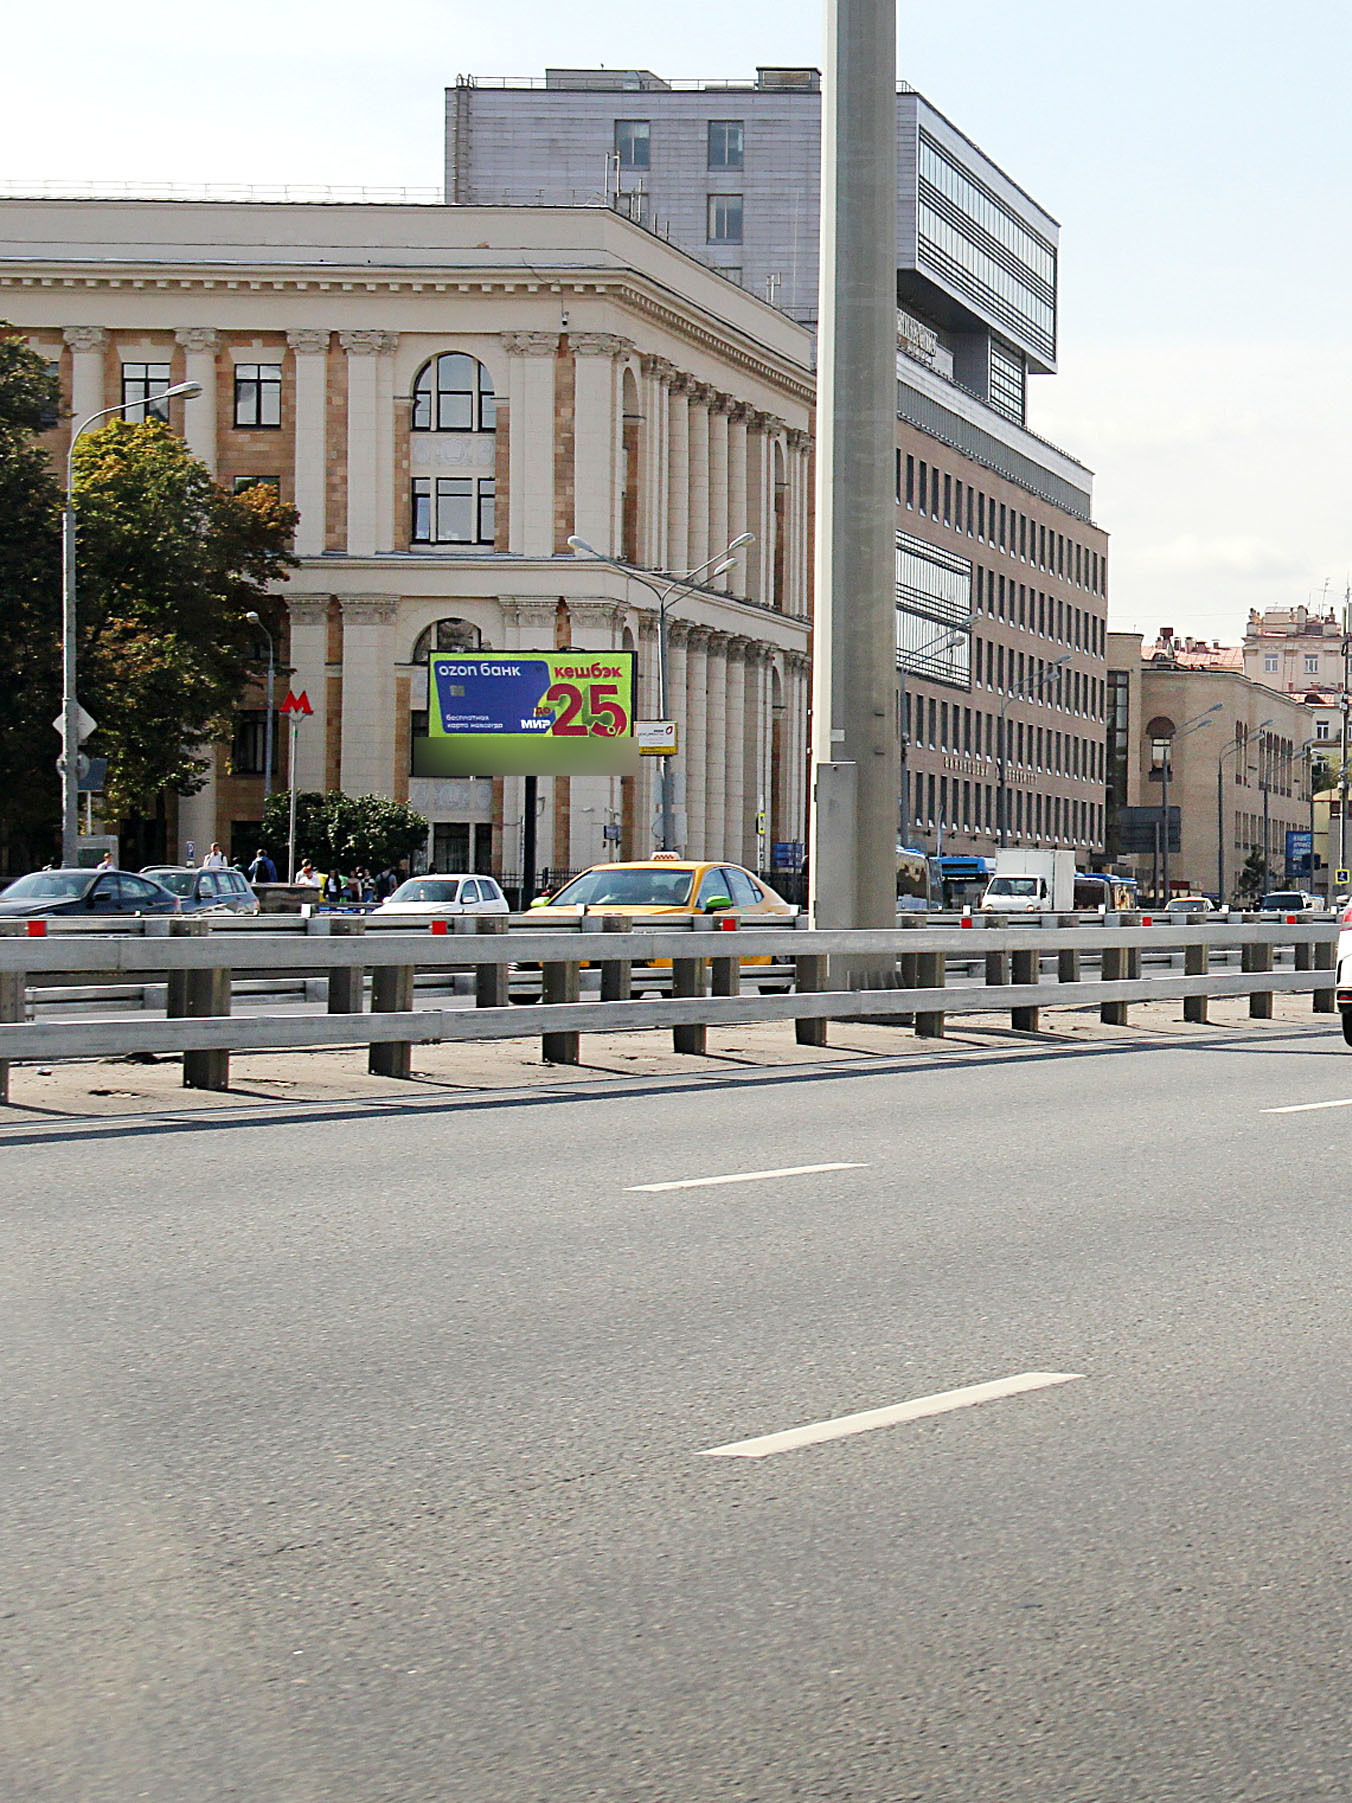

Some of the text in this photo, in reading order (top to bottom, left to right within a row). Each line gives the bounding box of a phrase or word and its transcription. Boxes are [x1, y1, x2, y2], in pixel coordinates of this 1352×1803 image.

[438, 662, 521, 676] ozon банк
[554, 662, 623, 678] кешбэк
[535, 706, 552, 717] до
[446, 713, 490, 721] бесплатная
[447, 722, 469, 730] карта
[520, 719, 552, 729] МИР
